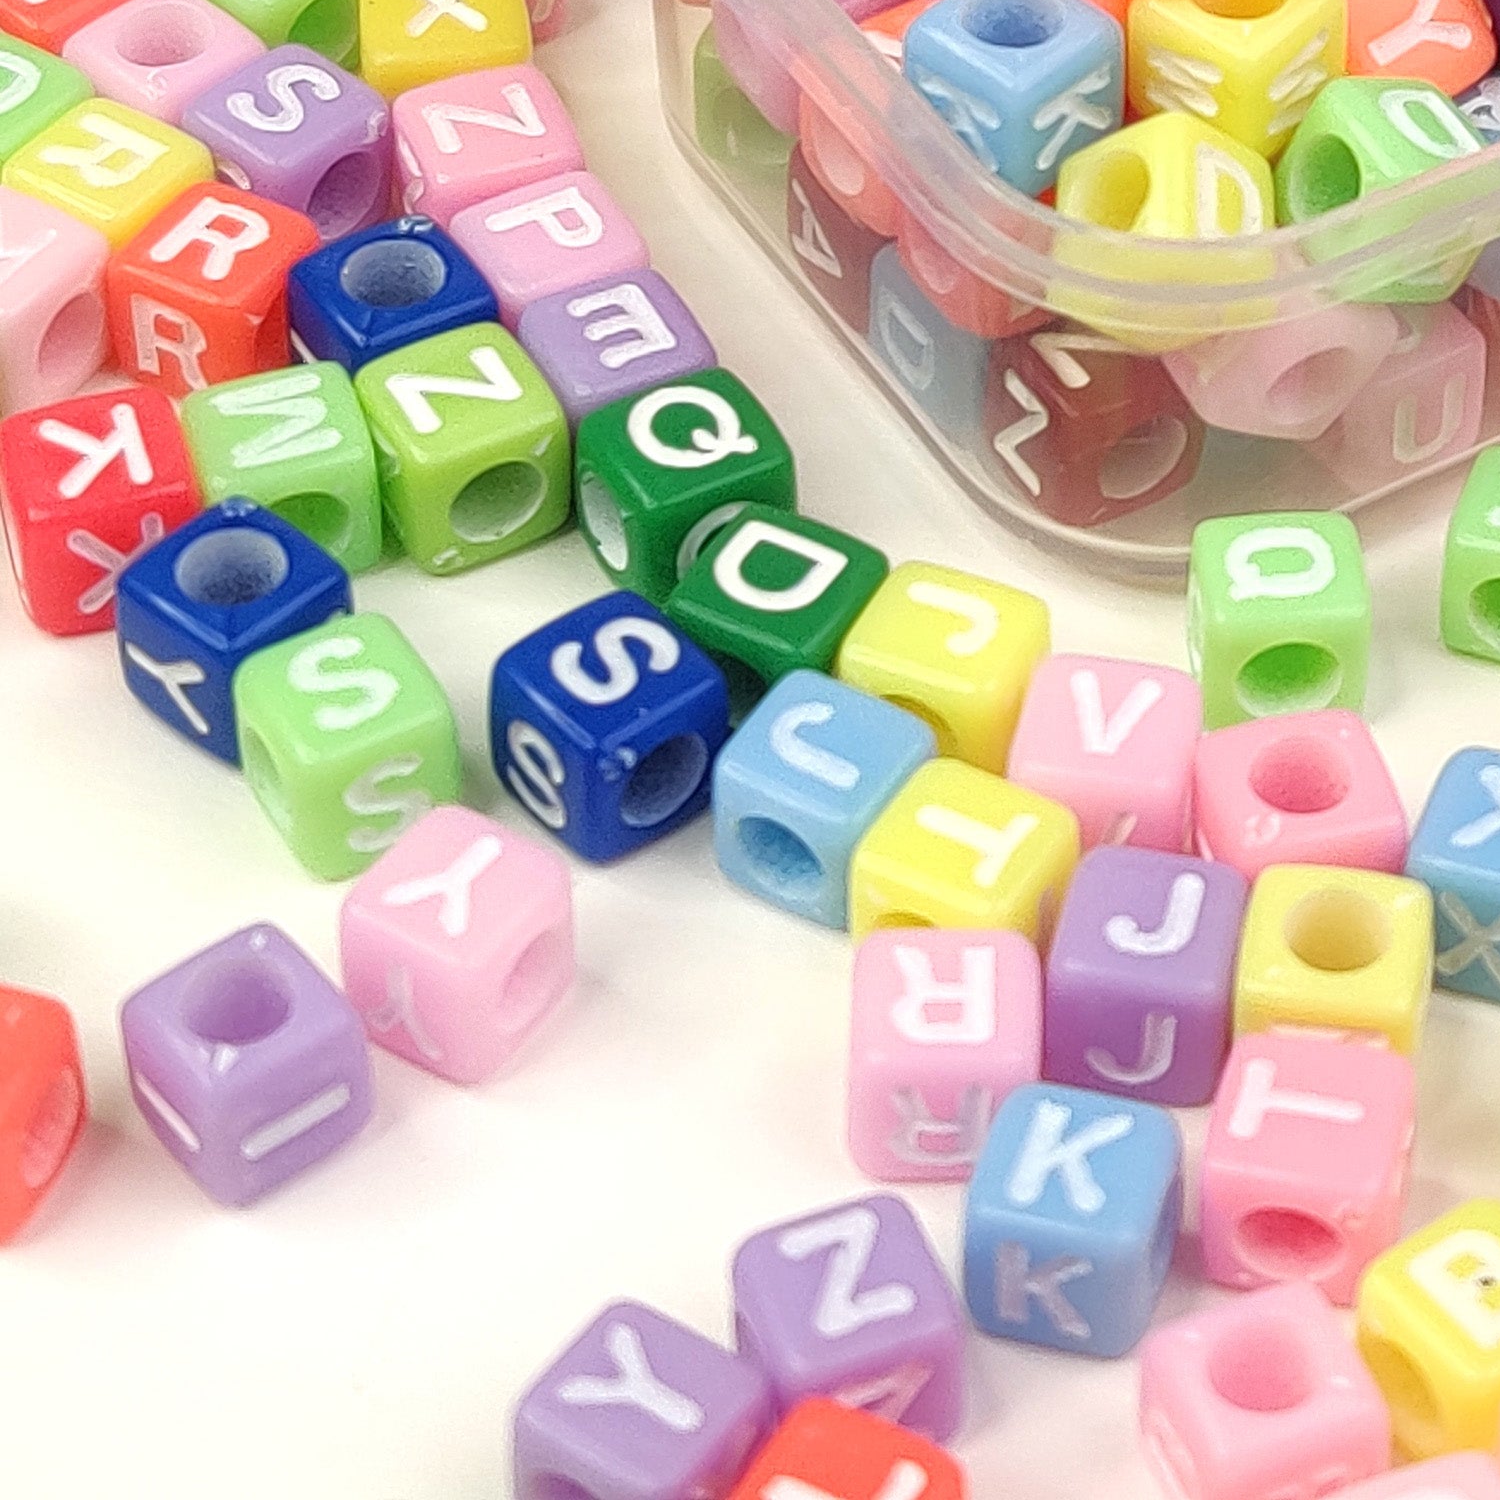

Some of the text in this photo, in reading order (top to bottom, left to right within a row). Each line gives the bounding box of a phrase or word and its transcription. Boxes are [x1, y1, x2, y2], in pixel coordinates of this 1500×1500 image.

[226, 64, 343, 132] S
[37, 112, 171, 188] R
[149, 196, 270, 281] R
[484, 186, 605, 248] P
[129, 292, 209, 392] R
[566, 282, 678, 369] E
[38, 402, 154, 499] K
[627, 384, 759, 469] Q
[1392, 373, 1467, 464] U
[713, 519, 849, 612] D
[1224, 526, 1337, 602] Q
[550, 615, 681, 706] S
[906, 580, 1000, 655] J
[125, 642, 210, 735] Y
[287, 636, 399, 731] S
[1070, 670, 1165, 754] V
[769, 700, 861, 791] J
[342, 753, 434, 853] S
[915, 804, 1042, 887] T
[381, 833, 503, 937] Y
[1104, 871, 1205, 957] J
[892, 944, 995, 1045] R
[1084, 1012, 1178, 1086] J
[240, 1084, 352, 1159] I
[885, 1083, 993, 1165] R
[1228, 1058, 1364, 1139] T
[1008, 1099, 1134, 1213] K
[993, 1240, 1093, 1339] K
[558, 1322, 706, 1432] Y
